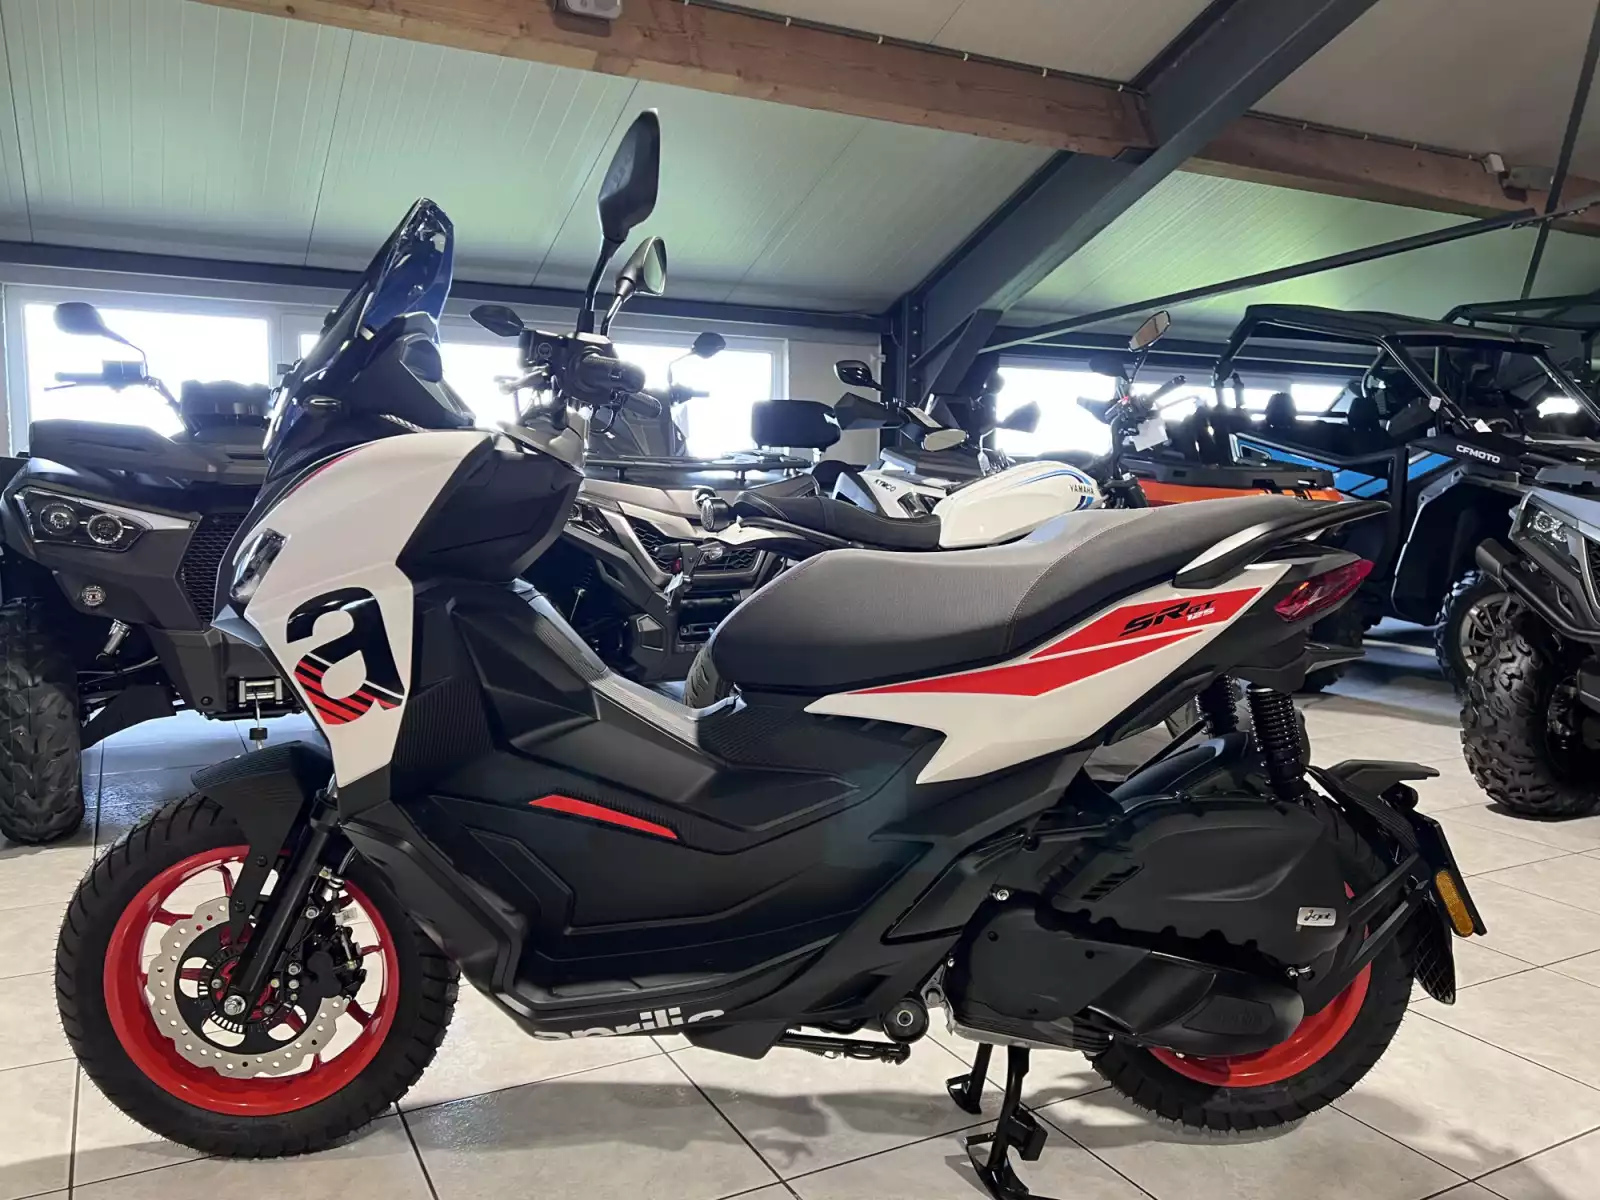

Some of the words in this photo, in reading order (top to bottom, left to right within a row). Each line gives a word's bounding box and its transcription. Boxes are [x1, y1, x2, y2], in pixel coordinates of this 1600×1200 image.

[1456, 444, 1501, 464] CFMOTO
[874, 478, 897, 492] KYMCO
[1070, 484, 1095, 495] YAMAHA
[1119, 600, 1191, 637] SR
[1186, 599, 1217, 615] GT
[1186, 607, 1216, 621] 125
